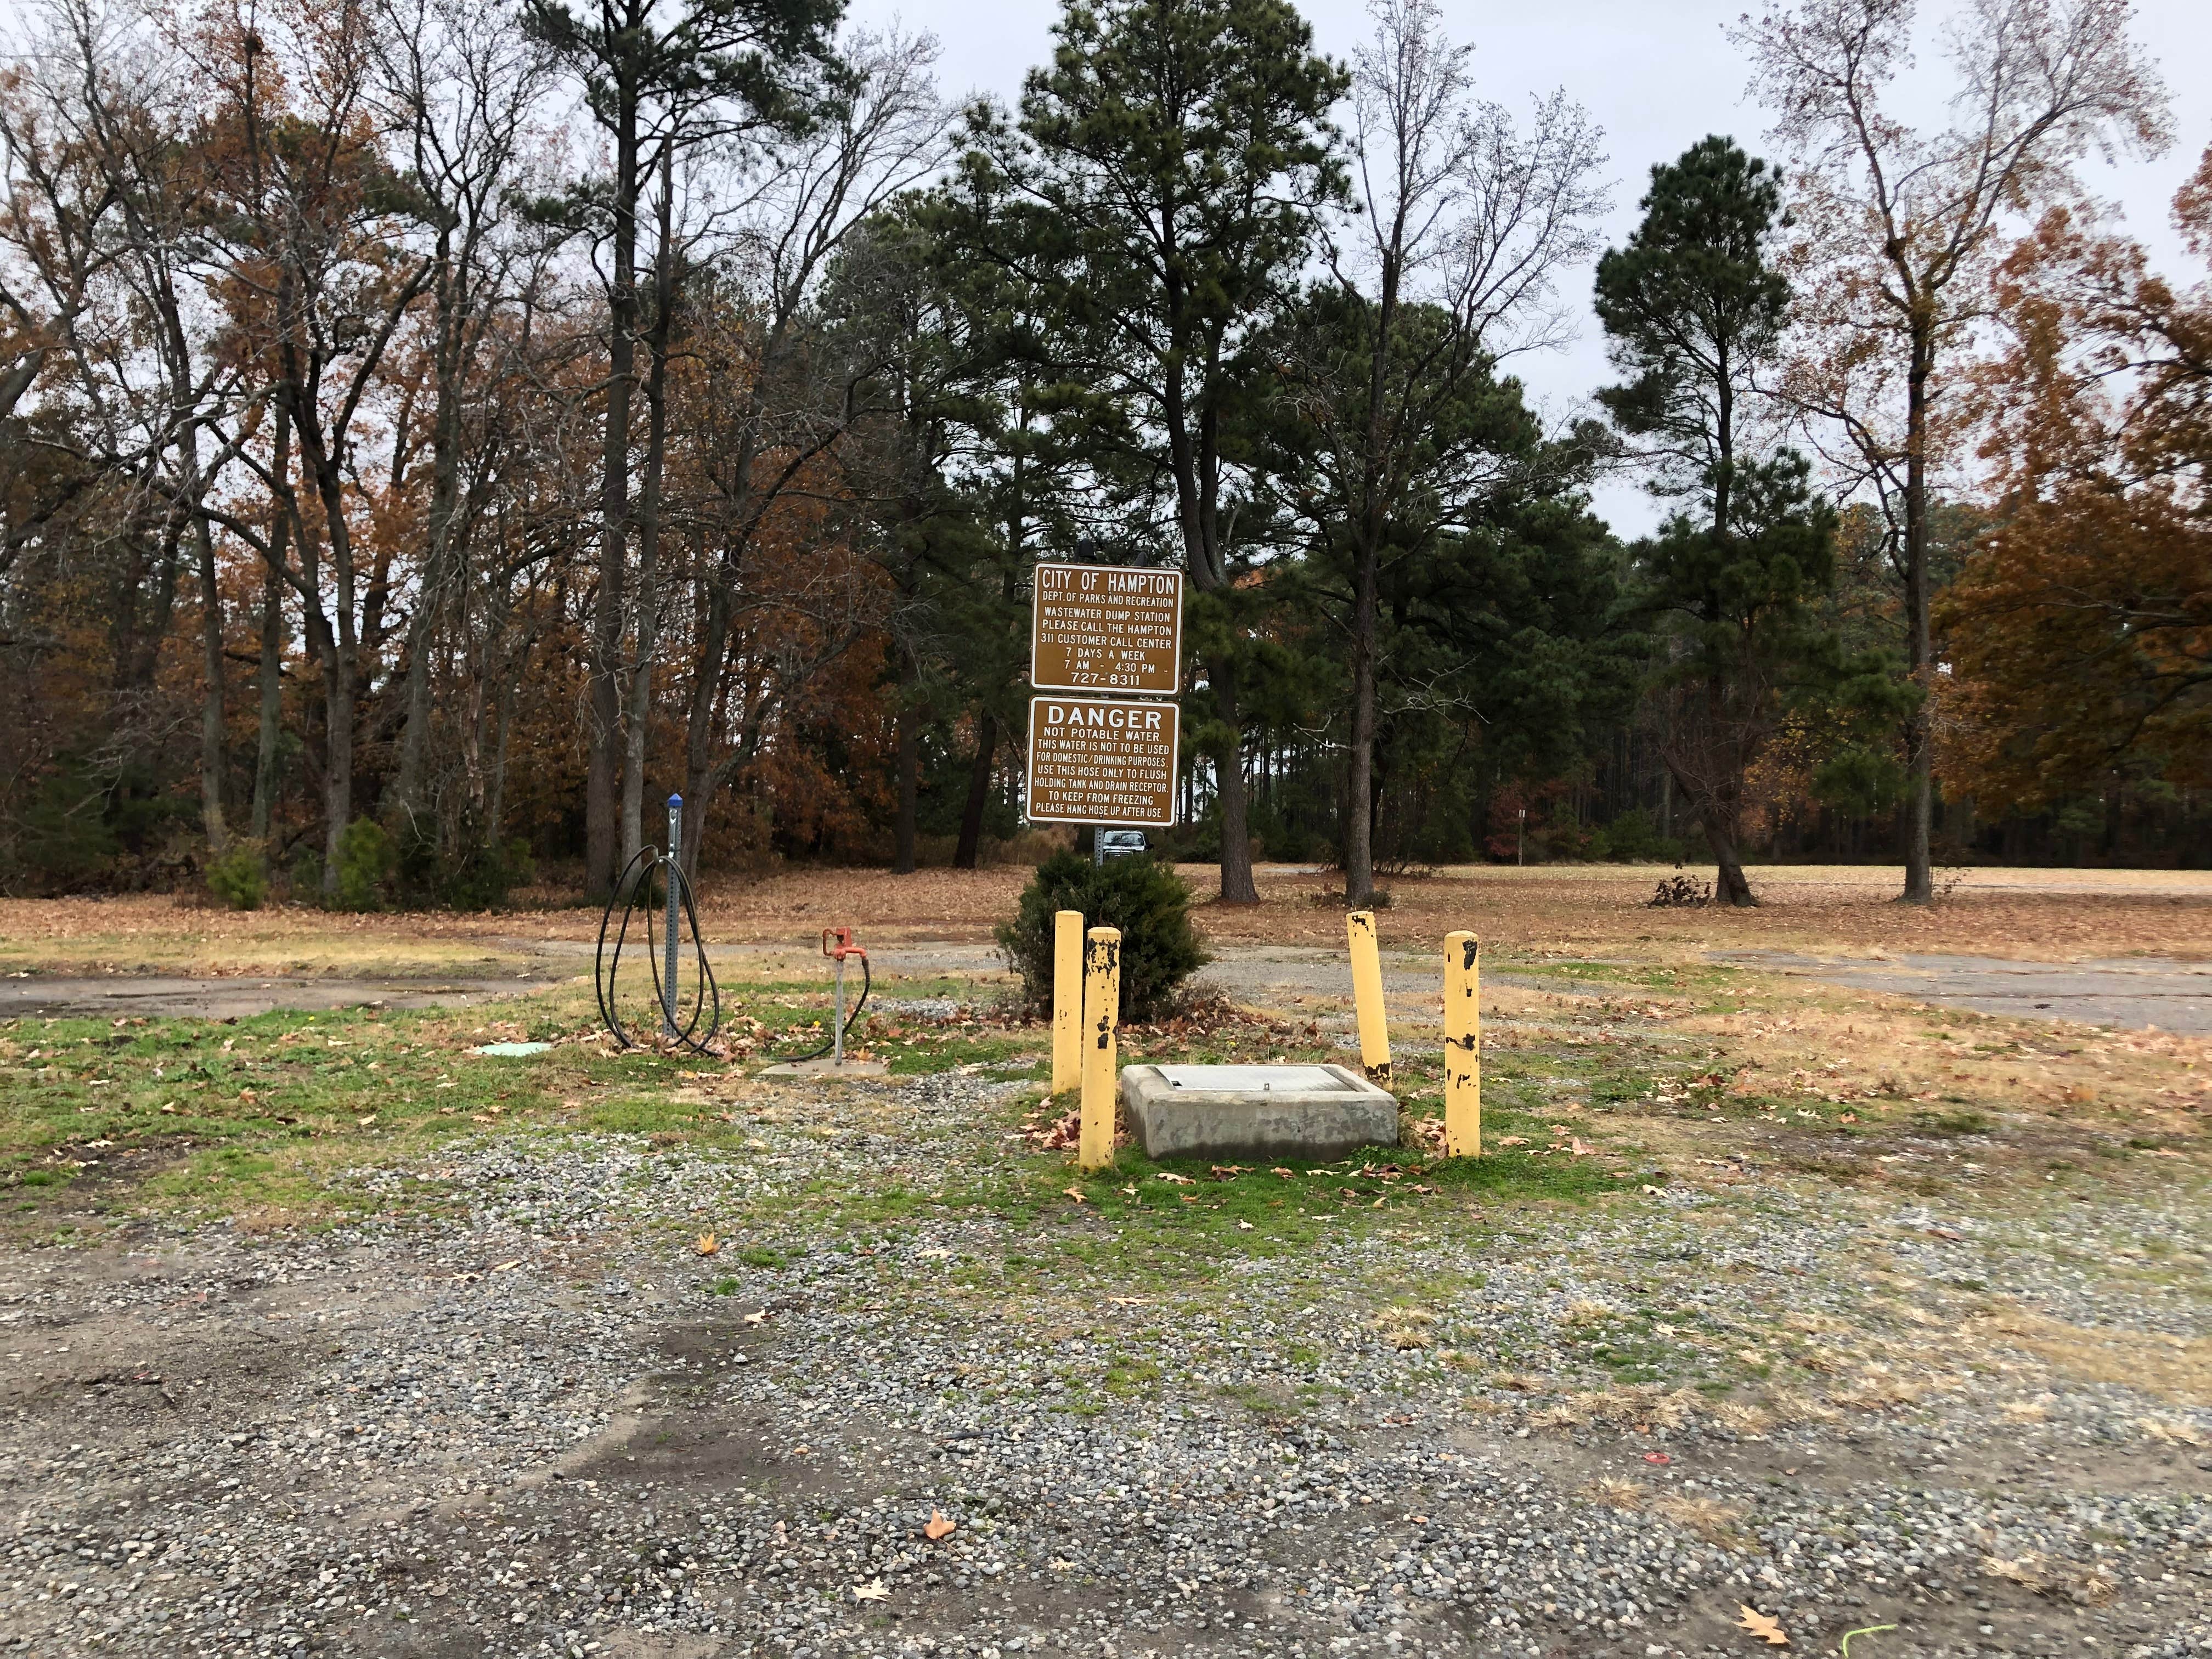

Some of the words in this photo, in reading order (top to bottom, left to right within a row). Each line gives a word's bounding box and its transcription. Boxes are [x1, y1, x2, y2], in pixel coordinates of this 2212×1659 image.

[1042, 569, 1071, 589] CITY
[1081, 572, 1099, 590] OF
[1108, 573, 1175, 595] HAMPTON
[1066, 592, 1076, 602] OF
[1079, 593, 1105, 604] PARKS
[1108, 595, 1124, 605] AND
[1126, 596, 1173, 607] RECREATION
[1045, 607, 1102, 619] WASTEWATER
[1105, 610, 1130, 620] DUMP
[1135, 612, 1170, 623] STATION
[1042, 619, 1078, 630] PLEASE
[1081, 622, 1104, 632] CALL
[1107, 623, 1124, 634] THE
[1127, 624, 1172, 636] HAMPTON
[1041, 633, 1054, 643] 311
[1058, 634, 1107, 646] CUSTOMER
[1110, 637, 1133, 647] CALL
[1137, 639, 1171, 649] CENTER
[1066, 647, 1071, 657] 7
[1077, 648, 1102, 658] DAYS
[1108, 650, 1114, 659] A
[1121, 650, 1145, 661] WEEK
[1064, 660, 1070, 669] 7
[1076, 661, 1089, 669] AM
[1115, 663, 1137, 673] 4:30
[1142, 664, 1155, 673] PM
[1071, 672, 1139, 686] 727-8311
[1048, 706, 1161, 730] DANGER
[1044, 727, 1065, 737] NOT
[1071, 729, 1120, 740] POTABLE
[1038, 739, 1057, 749] THIS
[1059, 740, 1086, 751] WATER
[1090, 741, 1098, 751] IS
[1101, 742, 1118, 752] NOT
[1120, 743, 1130, 753] TO
[1133, 744, 1144, 753] BE
[1147, 744, 1169, 755] USED
[1037, 752, 1051, 761] FOR
[1037, 765, 1054, 775] USE
[1057, 765, 1075, 776] THIS
[1077, 767, 1099, 777] HOSE
[1102, 768, 1124, 778] ONLY
[1126, 769, 1137, 779] TO
[1139, 770, 1166, 780] FLUSH
[1035, 777, 1066, 788] HOLDING
[1069, 779, 1086, 789] TANK
[1088, 780, 1103, 790] AND
[1105, 781, 1127, 791] DRAIN
[1048, 791, 1059, 800] TO
[1062, 792, 1084, 802] KEEP
[1087, 793, 1110, 803] FROM
[1113, 794, 1153, 805] FREEZING
[1036, 803, 1064, 813] PLEASE
[1067, 804, 1087, 814] HANG
[1089, 805, 1108, 815] HOSE
[1110, 806, 1120, 816] UP
[1122, 807, 1144, 817] AFTER
